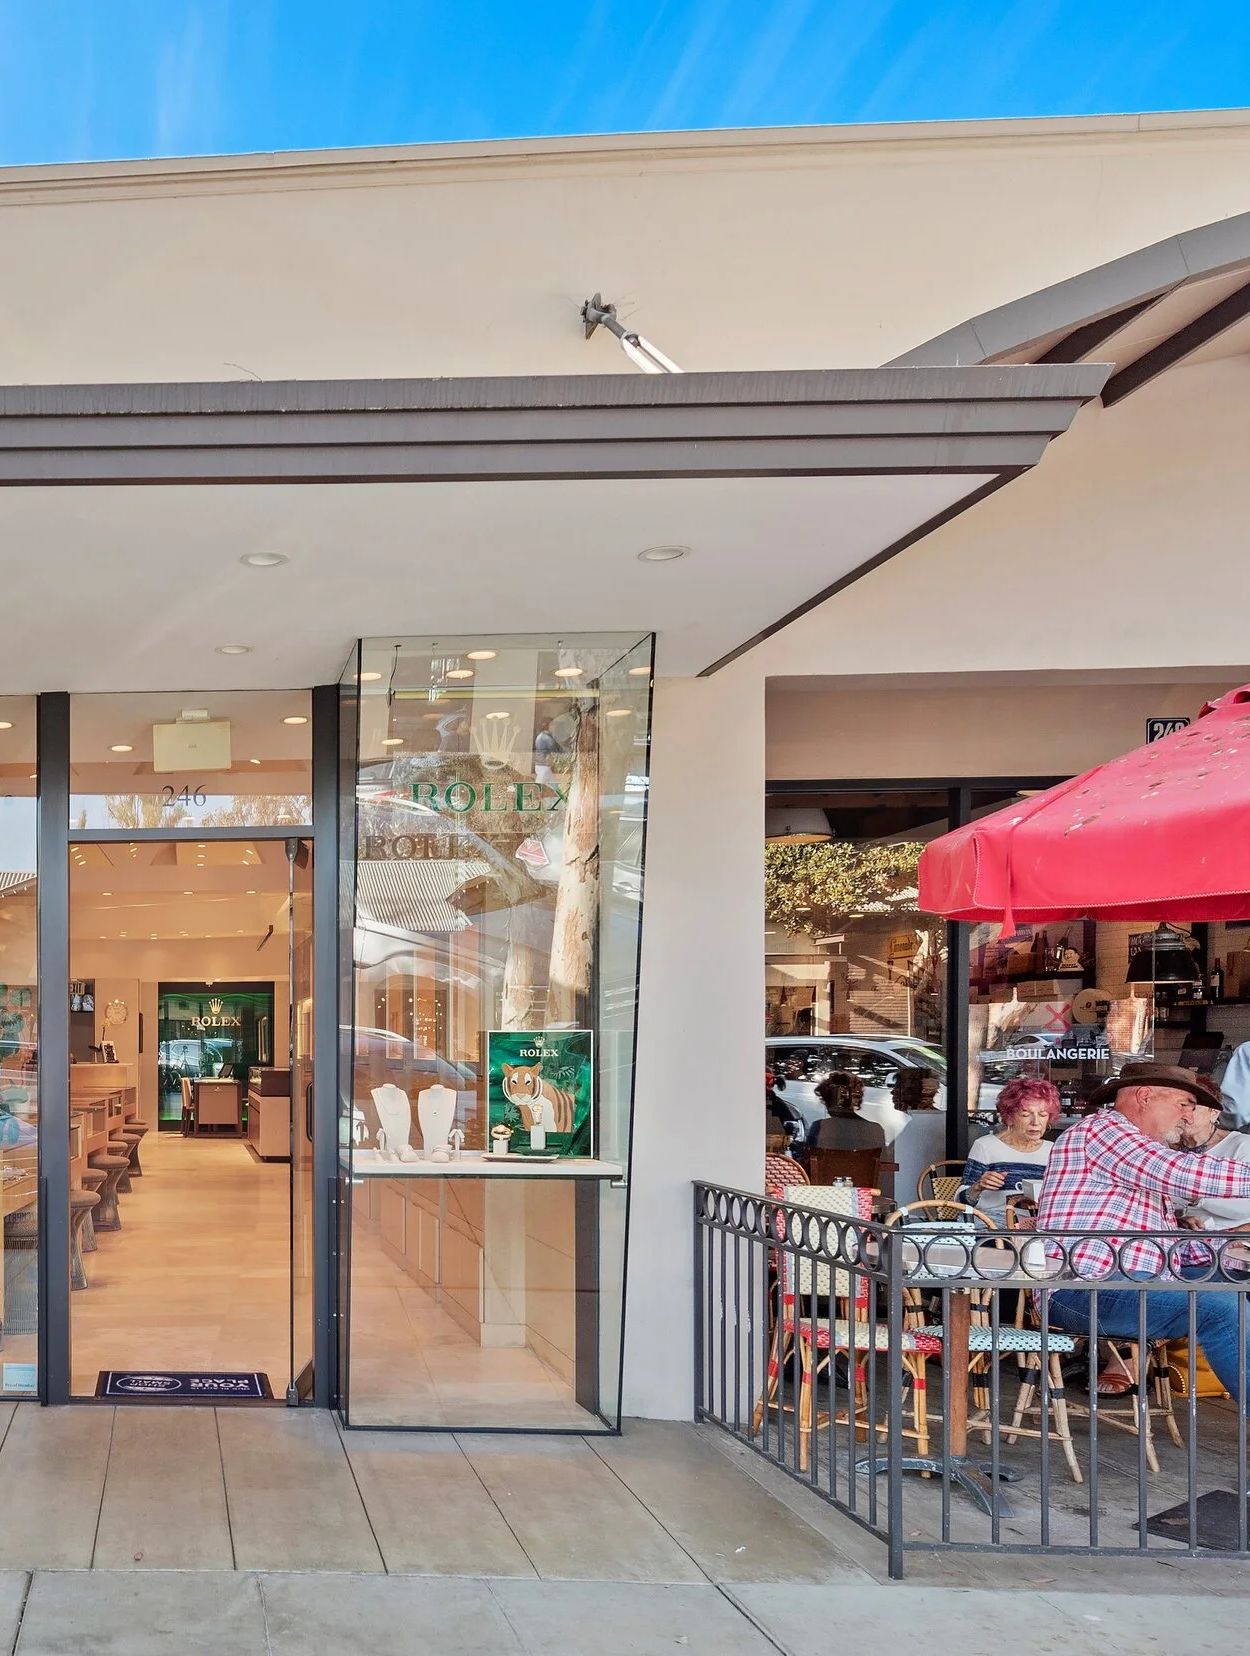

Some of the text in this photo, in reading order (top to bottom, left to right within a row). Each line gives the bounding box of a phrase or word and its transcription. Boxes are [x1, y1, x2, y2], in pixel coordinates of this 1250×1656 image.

[162, 784, 207, 807] 246
[191, 1016, 241, 1027] ROLEX
[519, 1049, 559, 1057] ROLEX
[1005, 1048, 1110, 1060] BOULANGERIE
